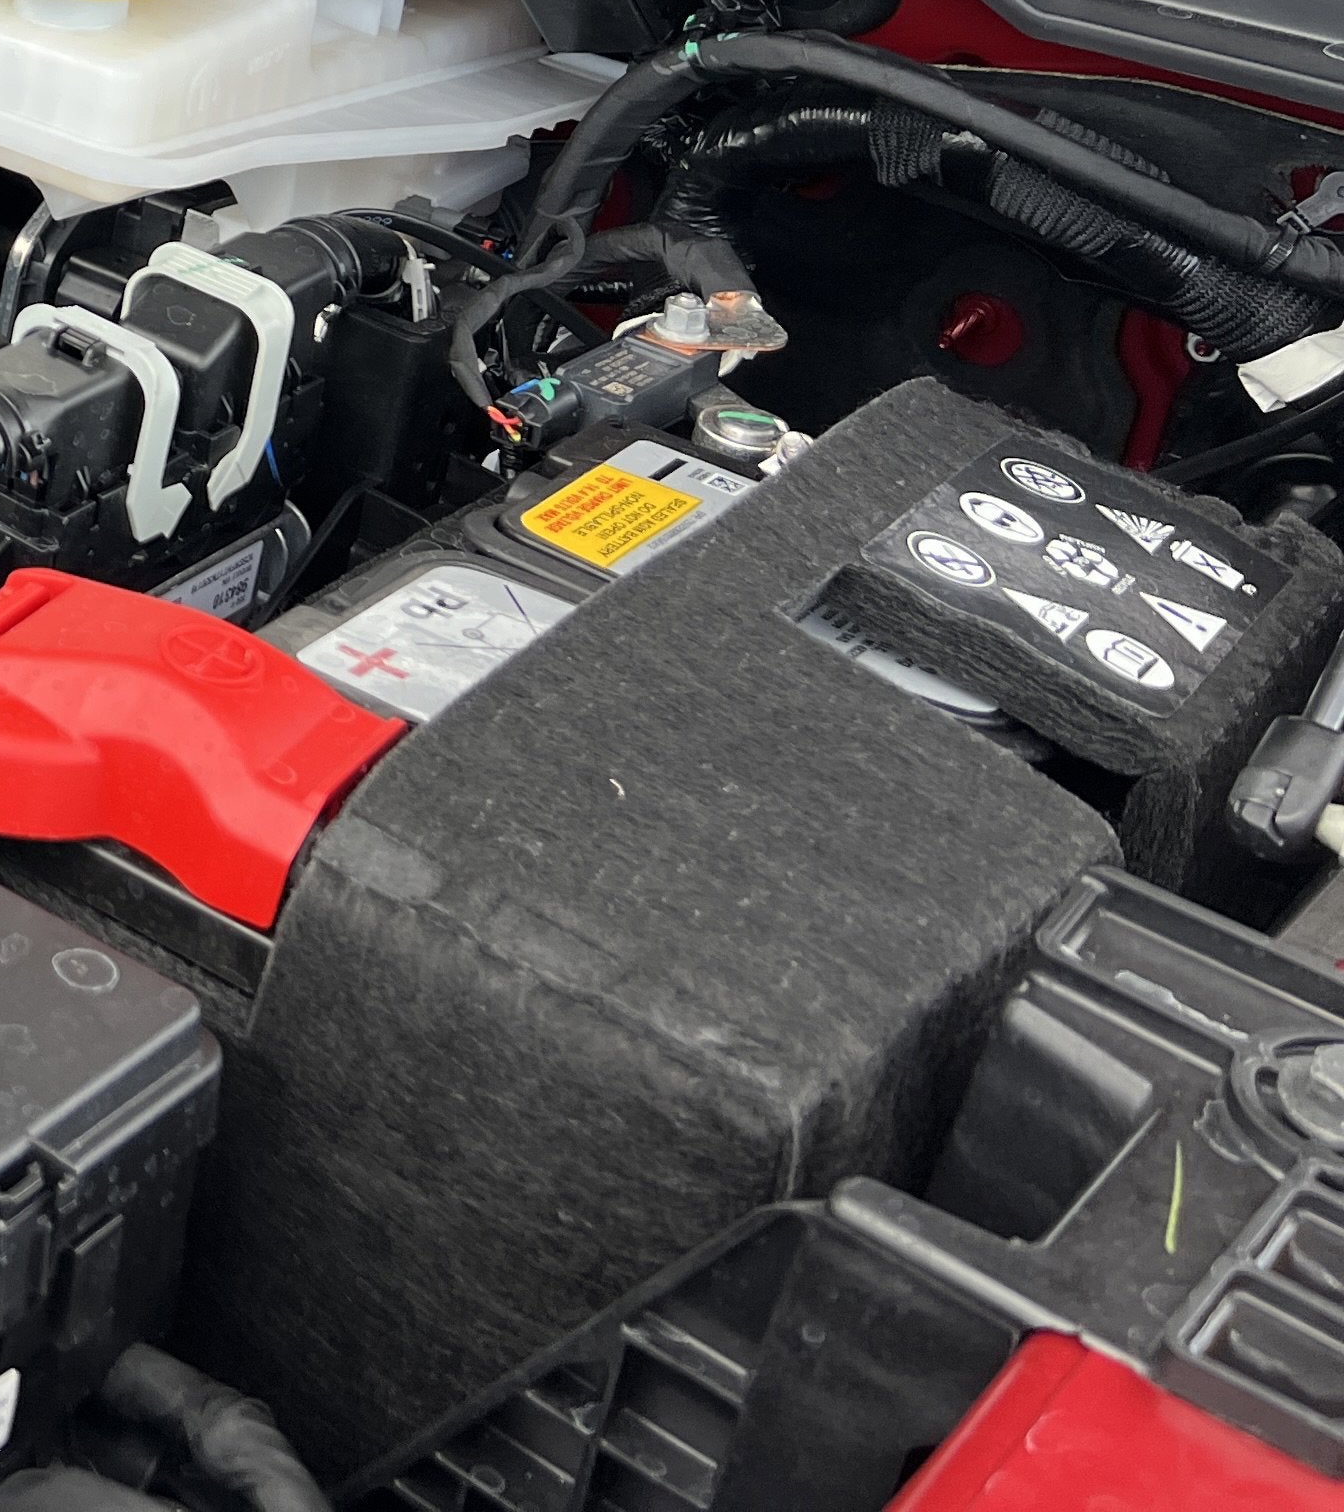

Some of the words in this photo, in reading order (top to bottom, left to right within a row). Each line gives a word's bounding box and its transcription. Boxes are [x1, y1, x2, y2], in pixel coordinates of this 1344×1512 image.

[636, 501, 657, 513] DO
[648, 497, 688, 522] SEALED
[619, 510, 644, 524] NOT
[595, 529, 639, 558] BATTERY
